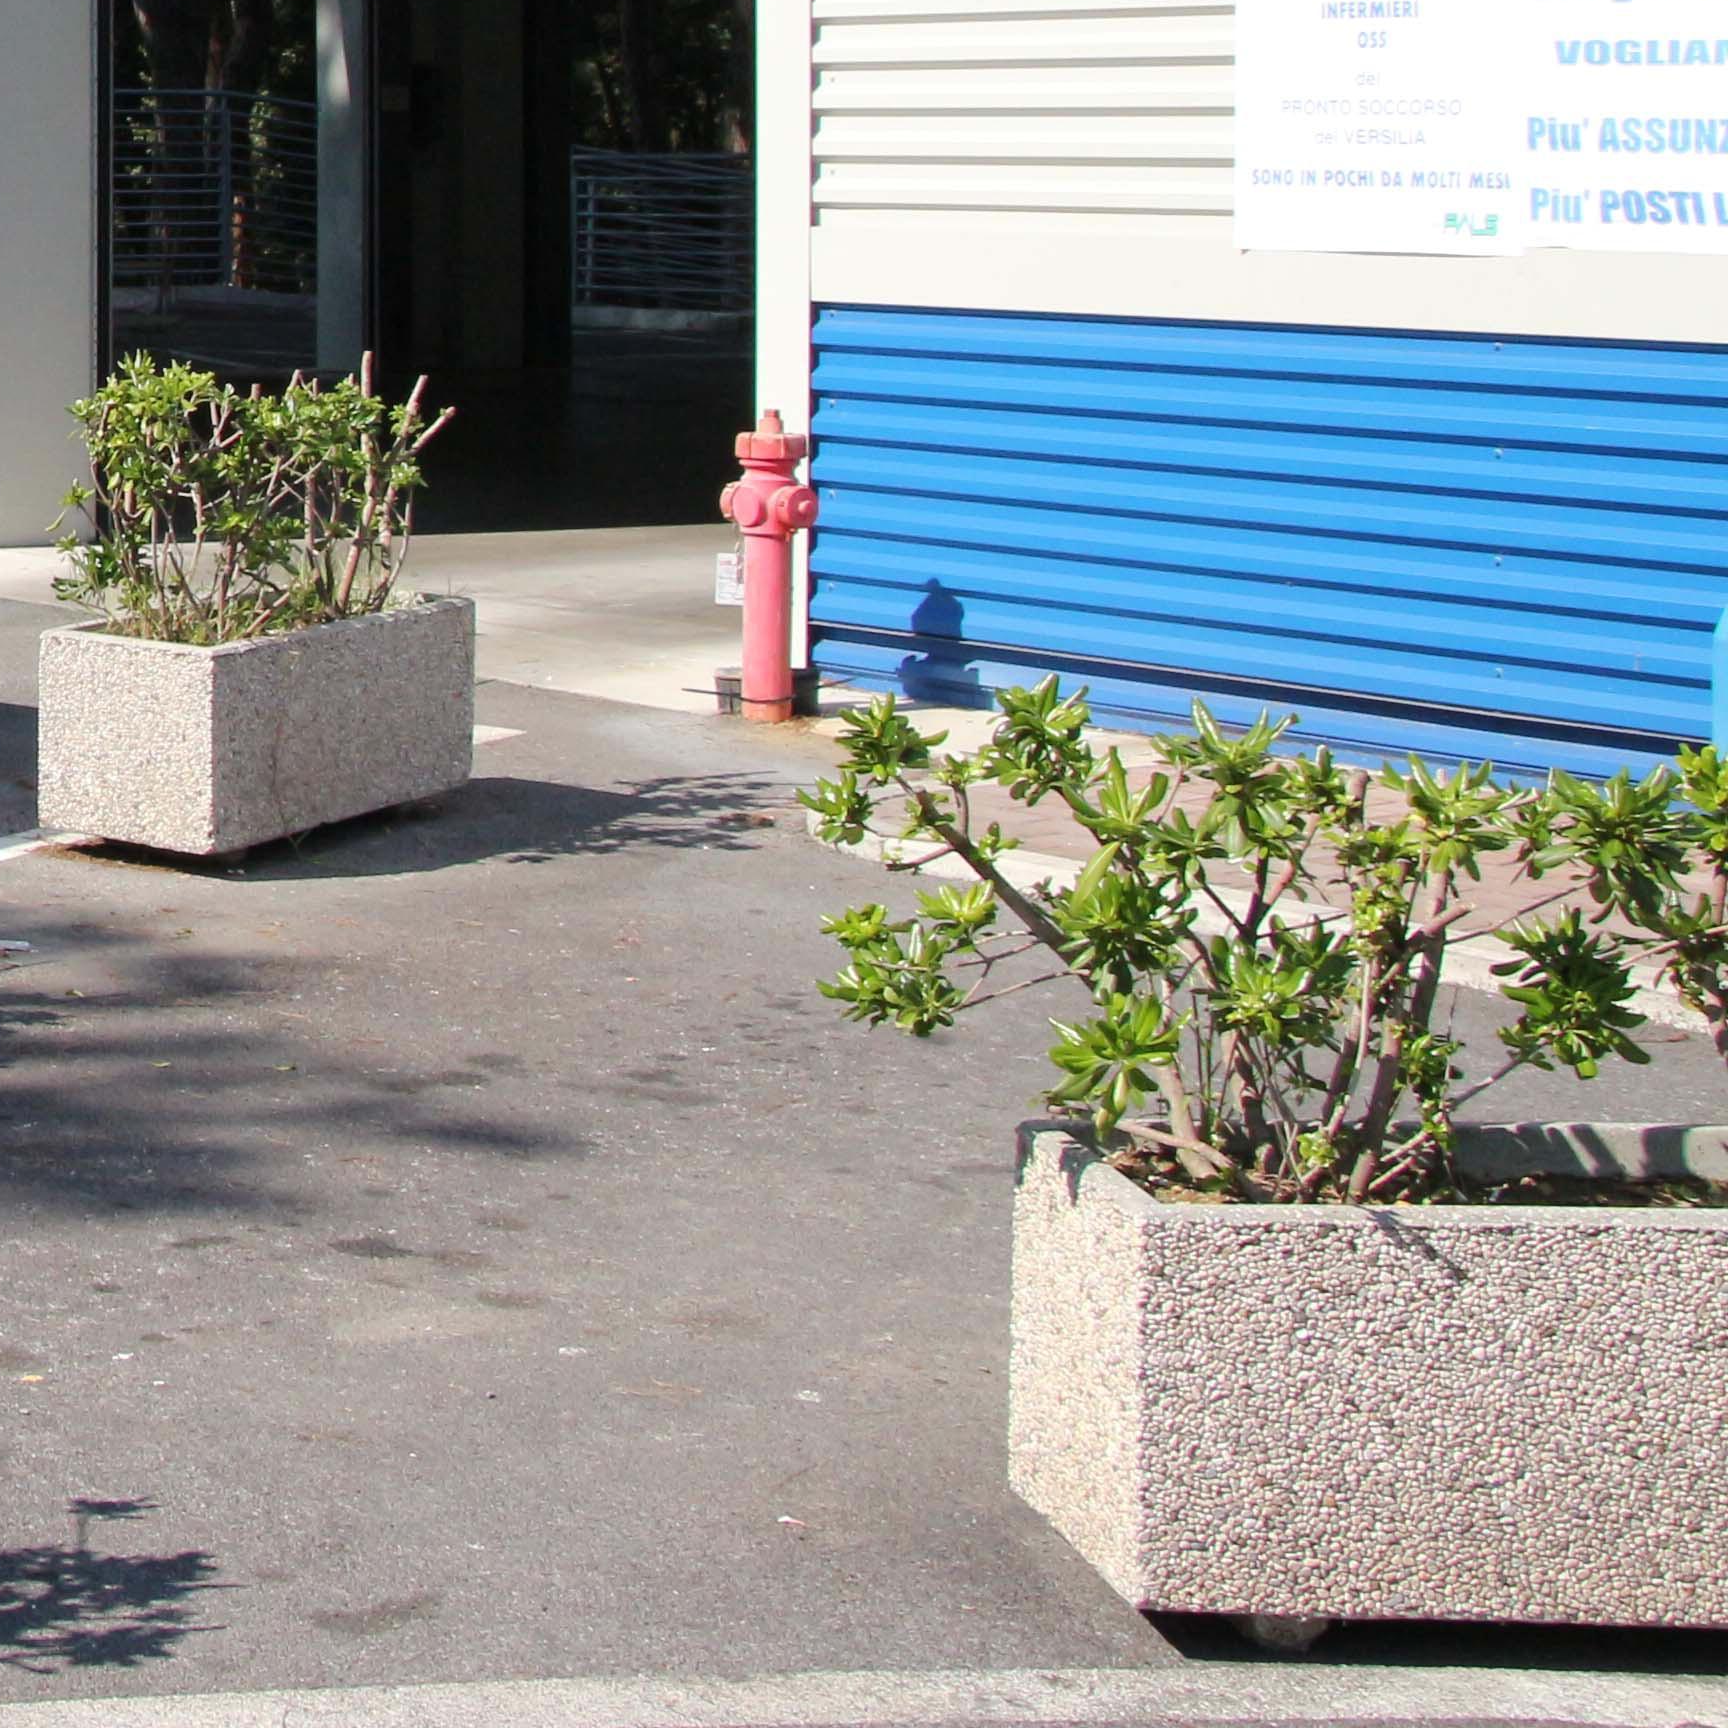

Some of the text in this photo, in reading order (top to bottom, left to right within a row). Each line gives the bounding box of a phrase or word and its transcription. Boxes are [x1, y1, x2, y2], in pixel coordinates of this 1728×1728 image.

[1321, 0, 1420, 19] INFERMIERI
[1357, 30, 1388, 49] OSS
[1281, 98, 1462, 117] PRONTO SOCCORSO
[1343, 128, 1426, 146] VERSILIA
[1251, 168, 1511, 191] SONO IN POCHI DA MOLTI MESI
[1600, 189, 1707, 226] POSTI
